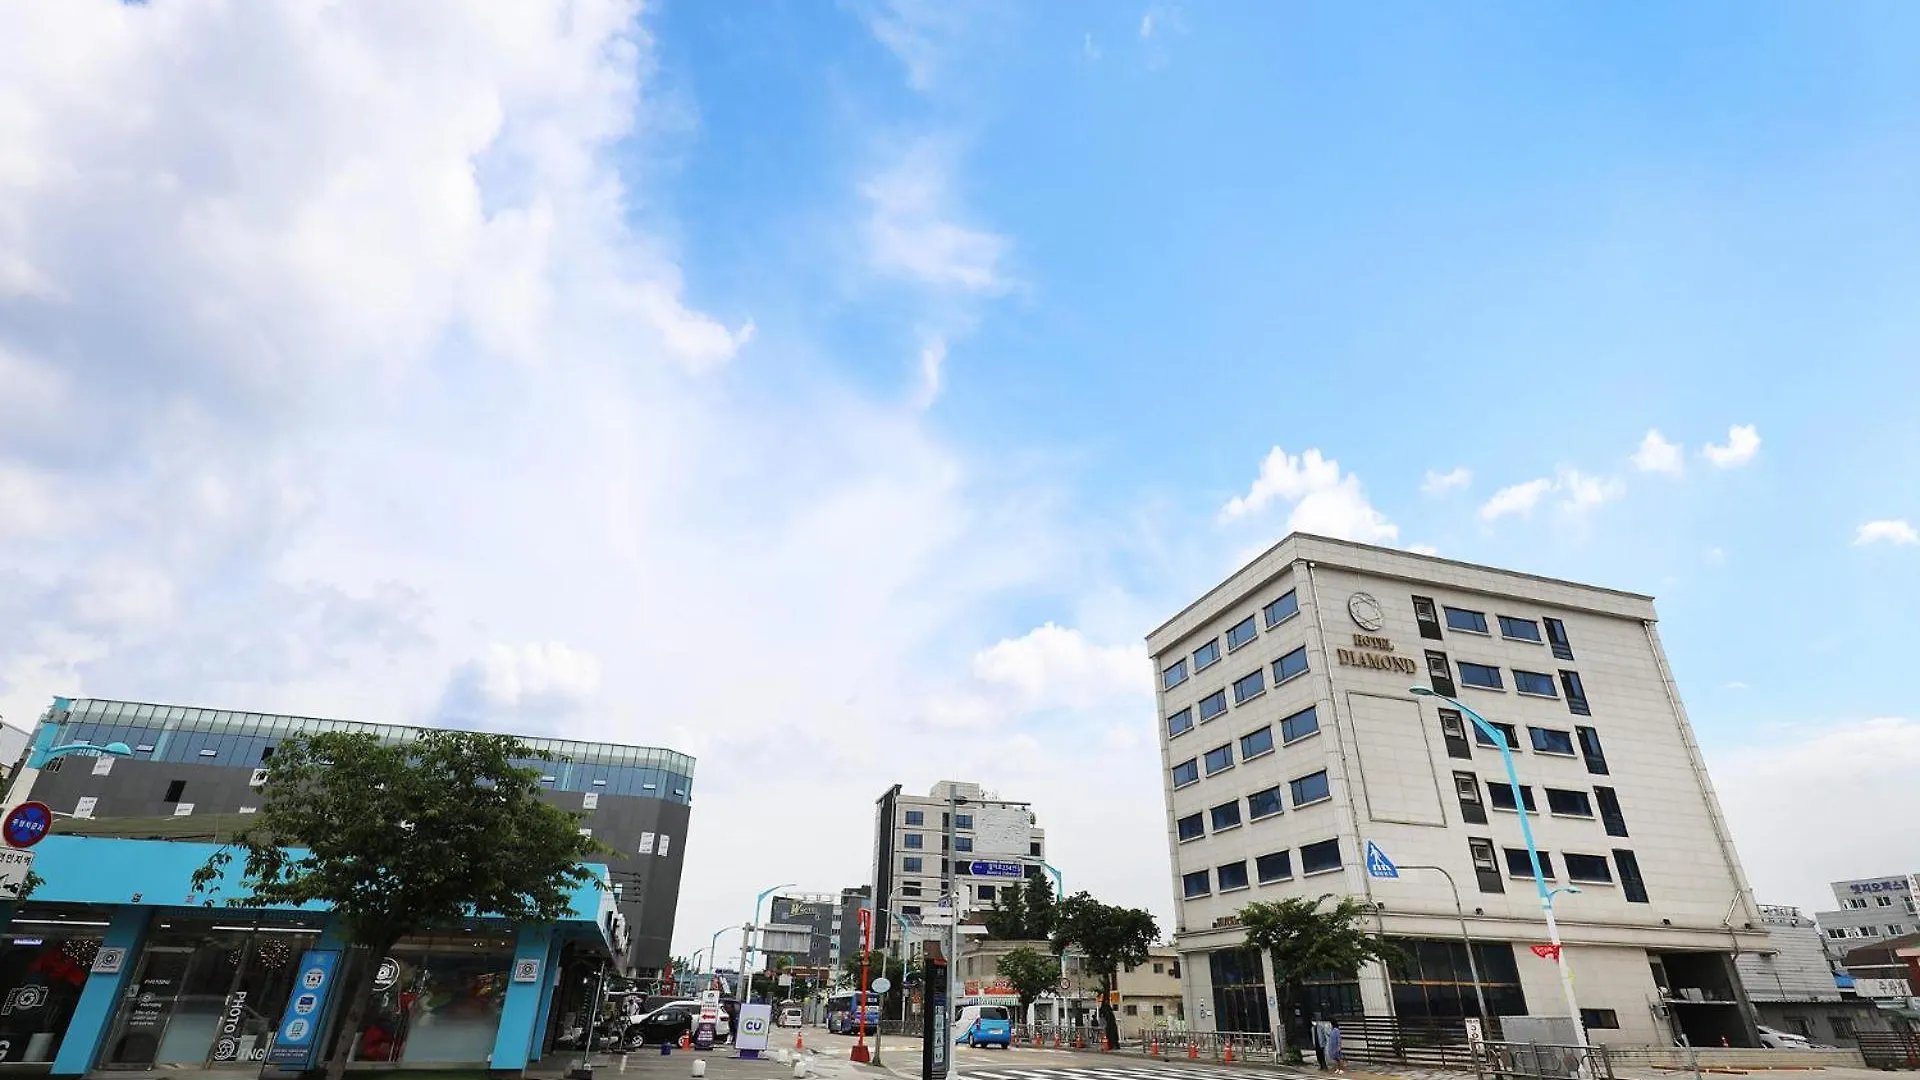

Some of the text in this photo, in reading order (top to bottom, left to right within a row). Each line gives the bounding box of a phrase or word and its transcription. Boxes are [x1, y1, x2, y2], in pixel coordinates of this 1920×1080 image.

[1353, 634, 1395, 652] HOTEL
[1337, 648, 1417, 674] DIAMOND
[223, 991, 247, 1034] PHOTO
[745, 1021, 762, 1030] CU
